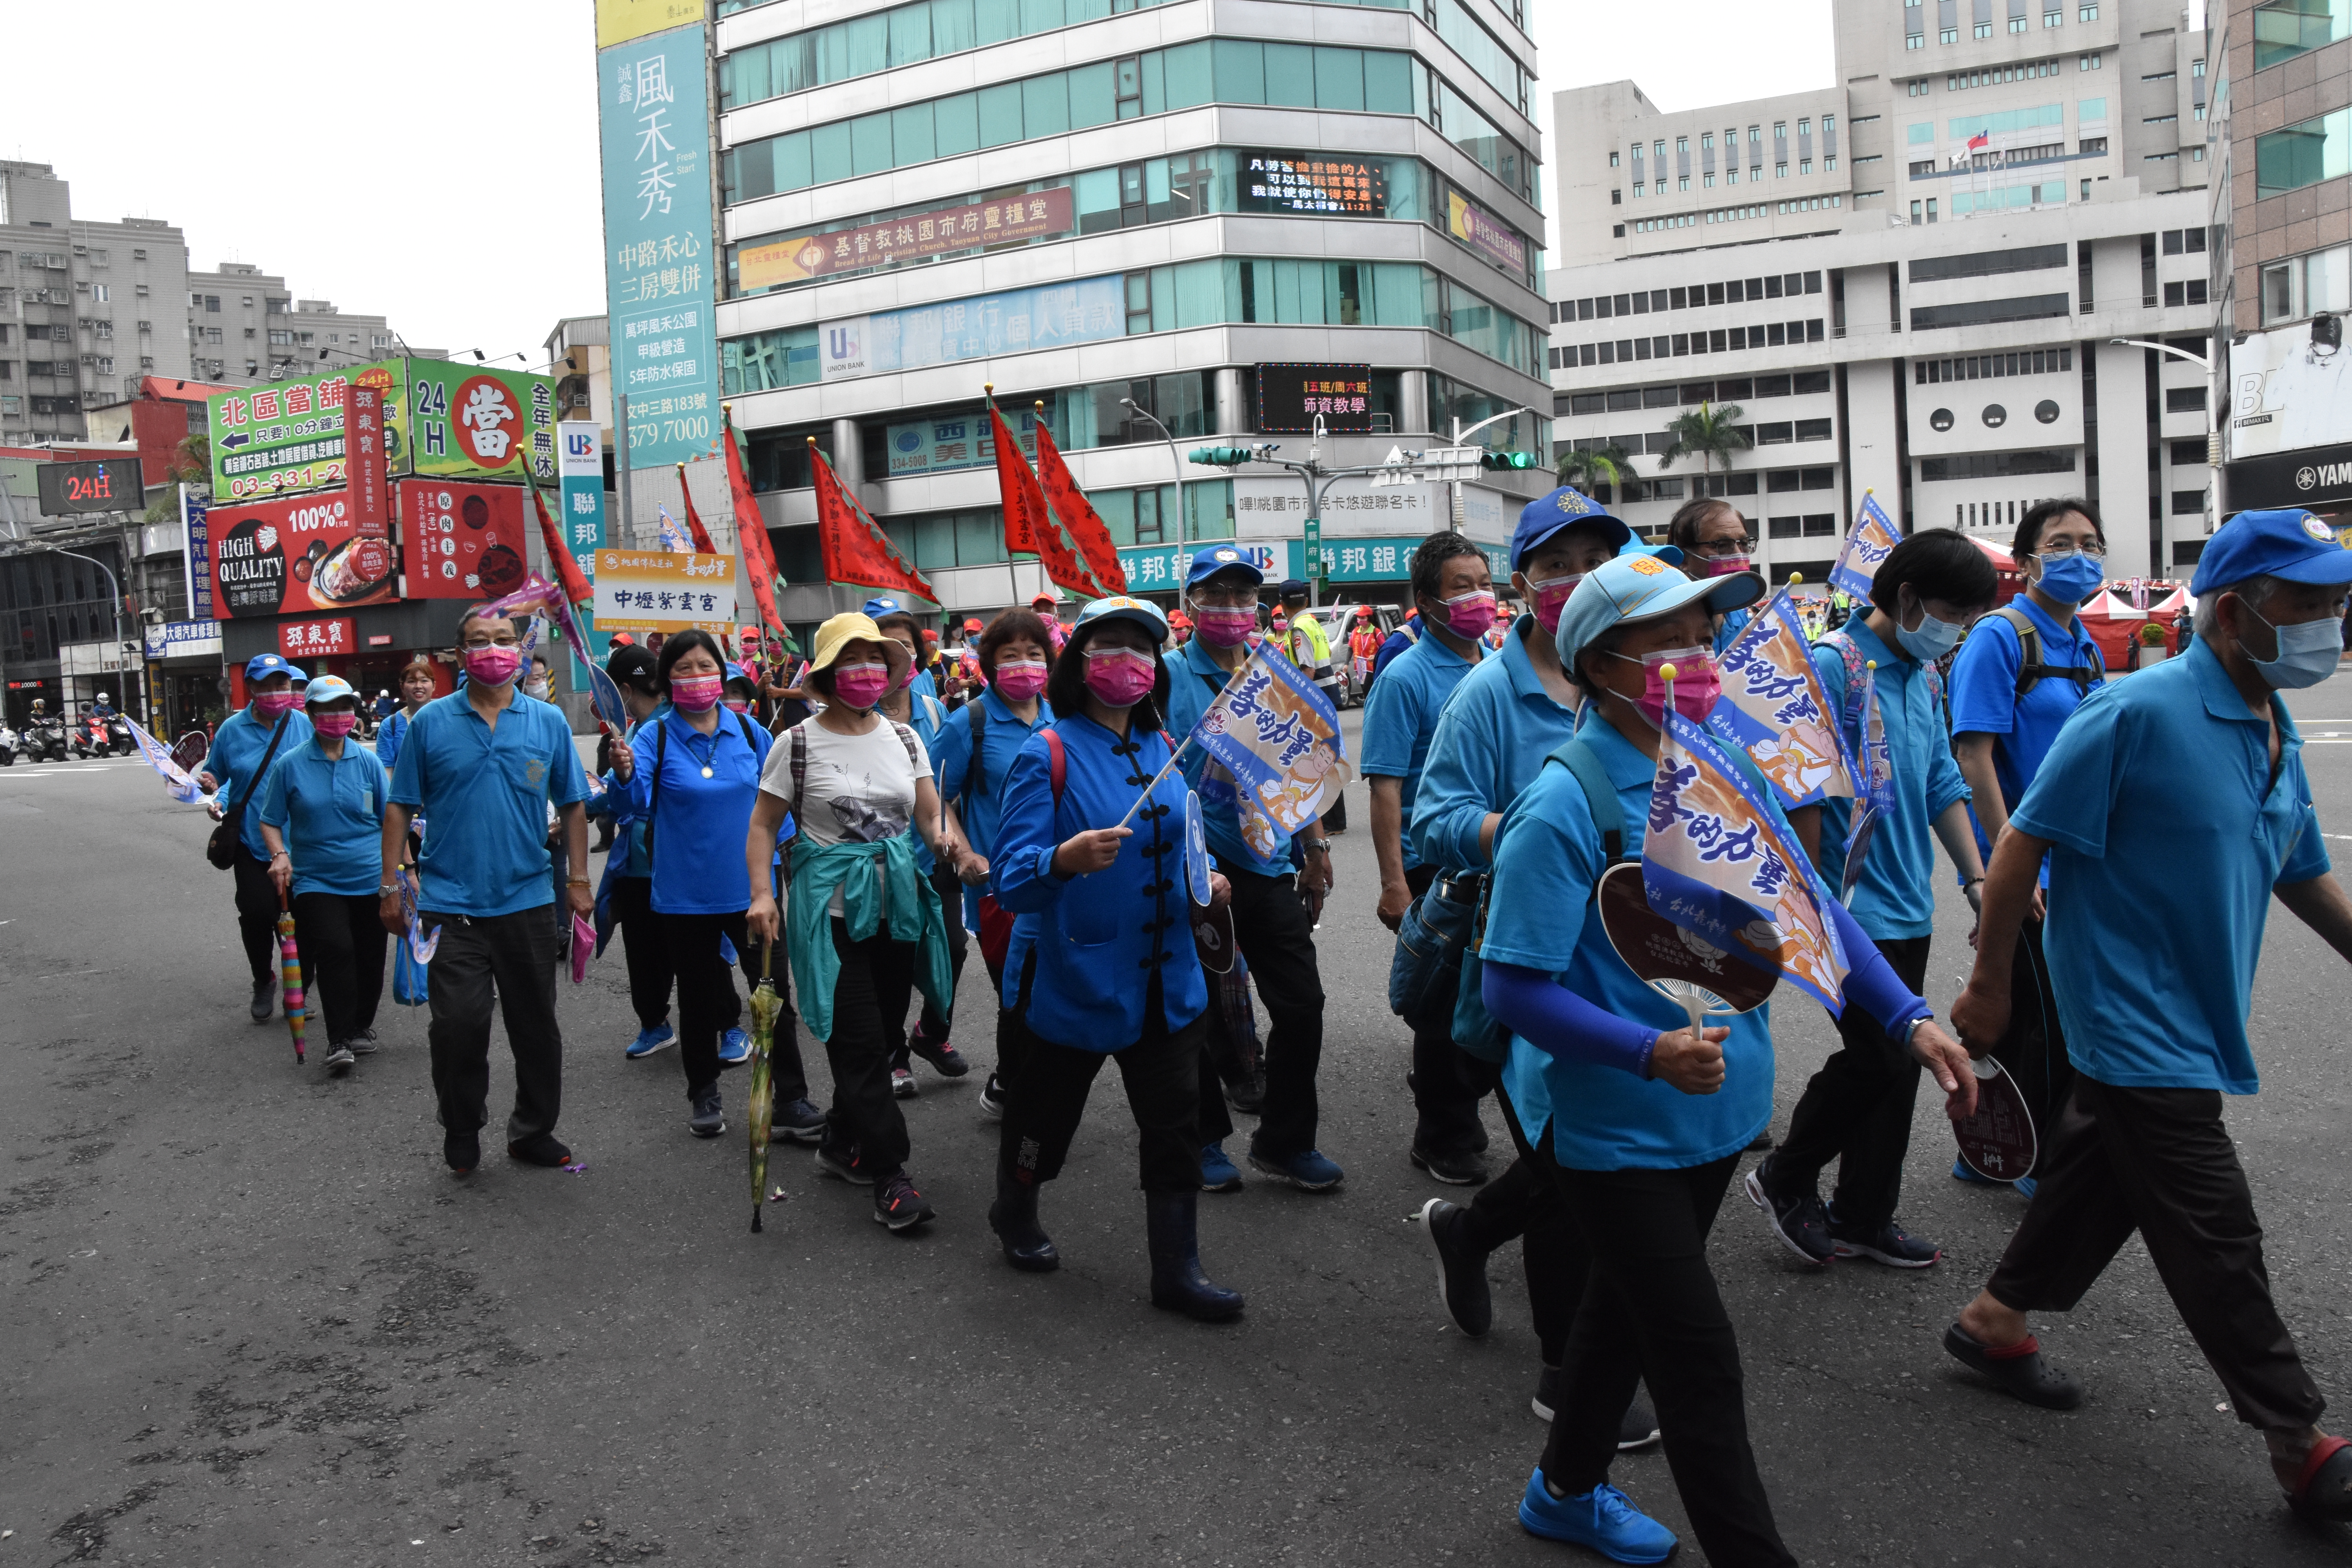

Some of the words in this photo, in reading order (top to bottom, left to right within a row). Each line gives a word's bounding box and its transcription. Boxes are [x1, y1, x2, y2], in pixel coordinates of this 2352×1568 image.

[618, 64, 632, 104] 誠鑫
[633, 54, 677, 221] 風禾秀
[677, 151, 696, 163] Fresh
[677, 163, 695, 175] Start
[835, 199, 1047, 257] 基督教桃園市府靈糧堂
[619, 231, 700, 271] 中路禾心
[835, 259, 855, 267] Bread
[951, 236, 980, 246] Taoyuan
[984, 232, 998, 241] City
[1002, 223, 1047, 236] Government
[620, 263, 701, 304] 三房雙併
[626, 311, 696, 339] 萬坪風禾公園
[875, 299, 999, 339] 聯邦銀行
[638, 338, 685, 360] 甲級營造
[630, 360, 696, 384] 5年防水保固
[827, 364, 846, 373] UNION
[848, 361, 865, 369] BANK
[628, 393, 707, 419] 文中三路183號
[463, 384, 514, 458] 當
[531, 382, 554, 477] 全年無休
[629, 423, 658, 448] 379
[664, 416, 708, 443] 7000
[892, 455, 927, 470] 334-5008
[67, 474, 112, 501] 24H
[364, 460, 374, 512] 台式牛排教父
[289, 505, 335, 532] 100%
[218, 537, 254, 559] HIGH
[440, 495, 455, 576] 原肉主義
[363, 551, 381, 560] 100%
[1307, 531, 1318, 572] 縣府路
[220, 557, 283, 582] QUALITY
[615, 590, 717, 612] 中壢紫雲宮
[167, 622, 221, 641] 大明汽車修理廠
[692, 622, 725, 633] 第二大隊
[298, 645, 338, 655] 台式牛排教父
[1650, 757, 1790, 895] 善的力量
[1018, 1136, 1040, 1170] NICE
